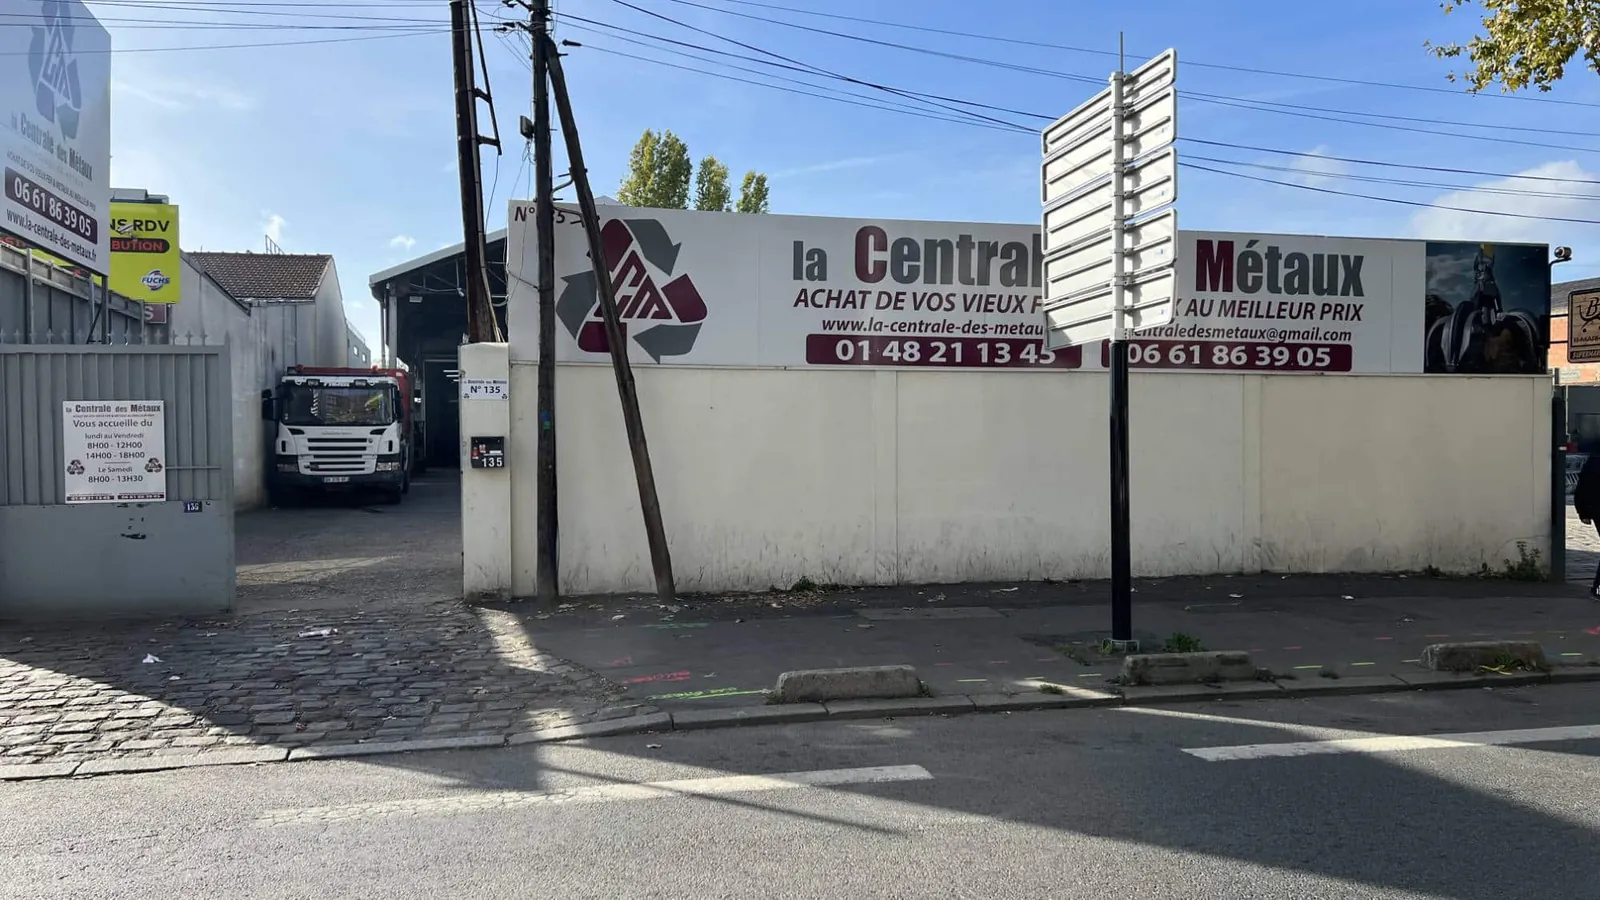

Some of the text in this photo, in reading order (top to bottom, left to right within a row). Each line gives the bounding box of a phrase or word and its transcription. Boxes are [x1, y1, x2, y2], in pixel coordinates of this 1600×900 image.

[15, 177, 30, 203] 06
[33, 188, 46, 212] 61
[49, 197, 62, 221] 86
[64, 206, 77, 228] 39
[79, 215, 91, 237] 05
[514, 206, 536, 222] N°
[133, 219, 170, 232] RDV
[7, 209, 97, 263] www.la-centrale-des-metaux.fr
[792, 240, 827, 282] la
[1195, 239, 1365, 297] Métaux
[141, 276, 171, 285] FUCHS
[793, 288, 872, 310] ACHAT
[875, 291, 907, 311] DE
[912, 291, 957, 313] VOS
[961, 293, 1028, 314] VIEUX
[1184, 298, 1215, 318] AU
[1217, 299, 1315, 321] MEILLEUR
[1319, 302, 1364, 322] PRIX
[822, 317, 1044, 336] www.la-centrale-des-metau
[835, 339, 1056, 365] 01 48 21 13 45
[1128, 343, 1331, 367] 06 61 86 39 05
[470, 385, 501, 394] N° 135
[75, 404, 112, 413] Centrale
[73, 418, 153, 428] Vous accueille du
[119, 451, 145, 459] 18H00
[481, 457, 503, 468] 135
